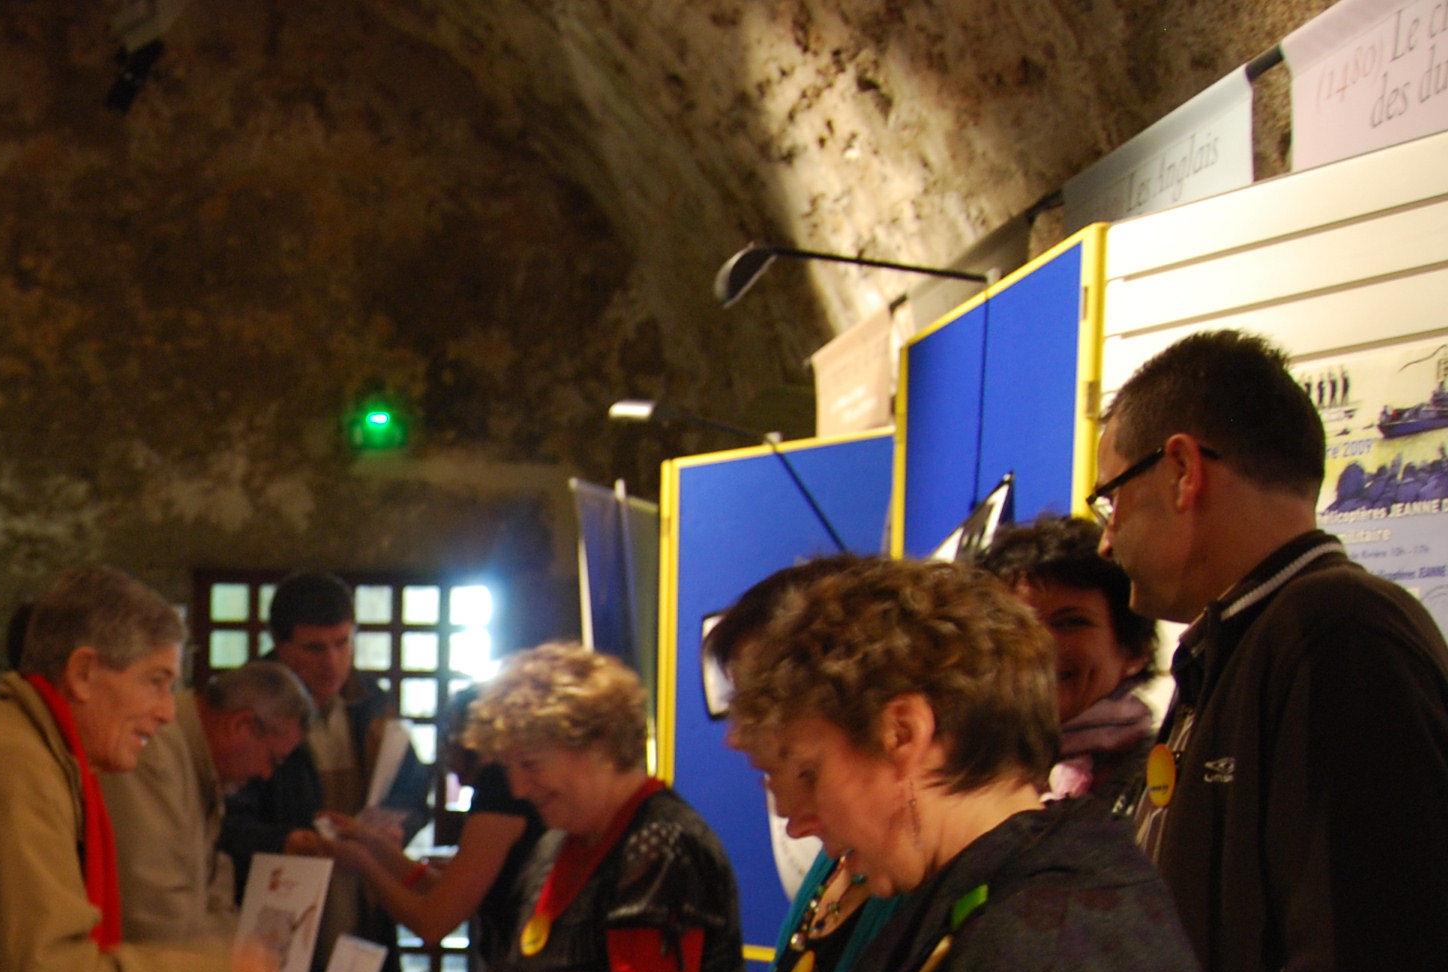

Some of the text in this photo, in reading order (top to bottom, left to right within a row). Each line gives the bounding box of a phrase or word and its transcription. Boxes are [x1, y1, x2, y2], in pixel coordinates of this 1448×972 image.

[1390, 9, 1420, 62] Le
[1371, 71, 1410, 128] des
[1125, 132, 1220, 213] Les Anglais
[1342, 439, 1374, 458] 2009
[1388, 498, 1441, 519] JEANNE
